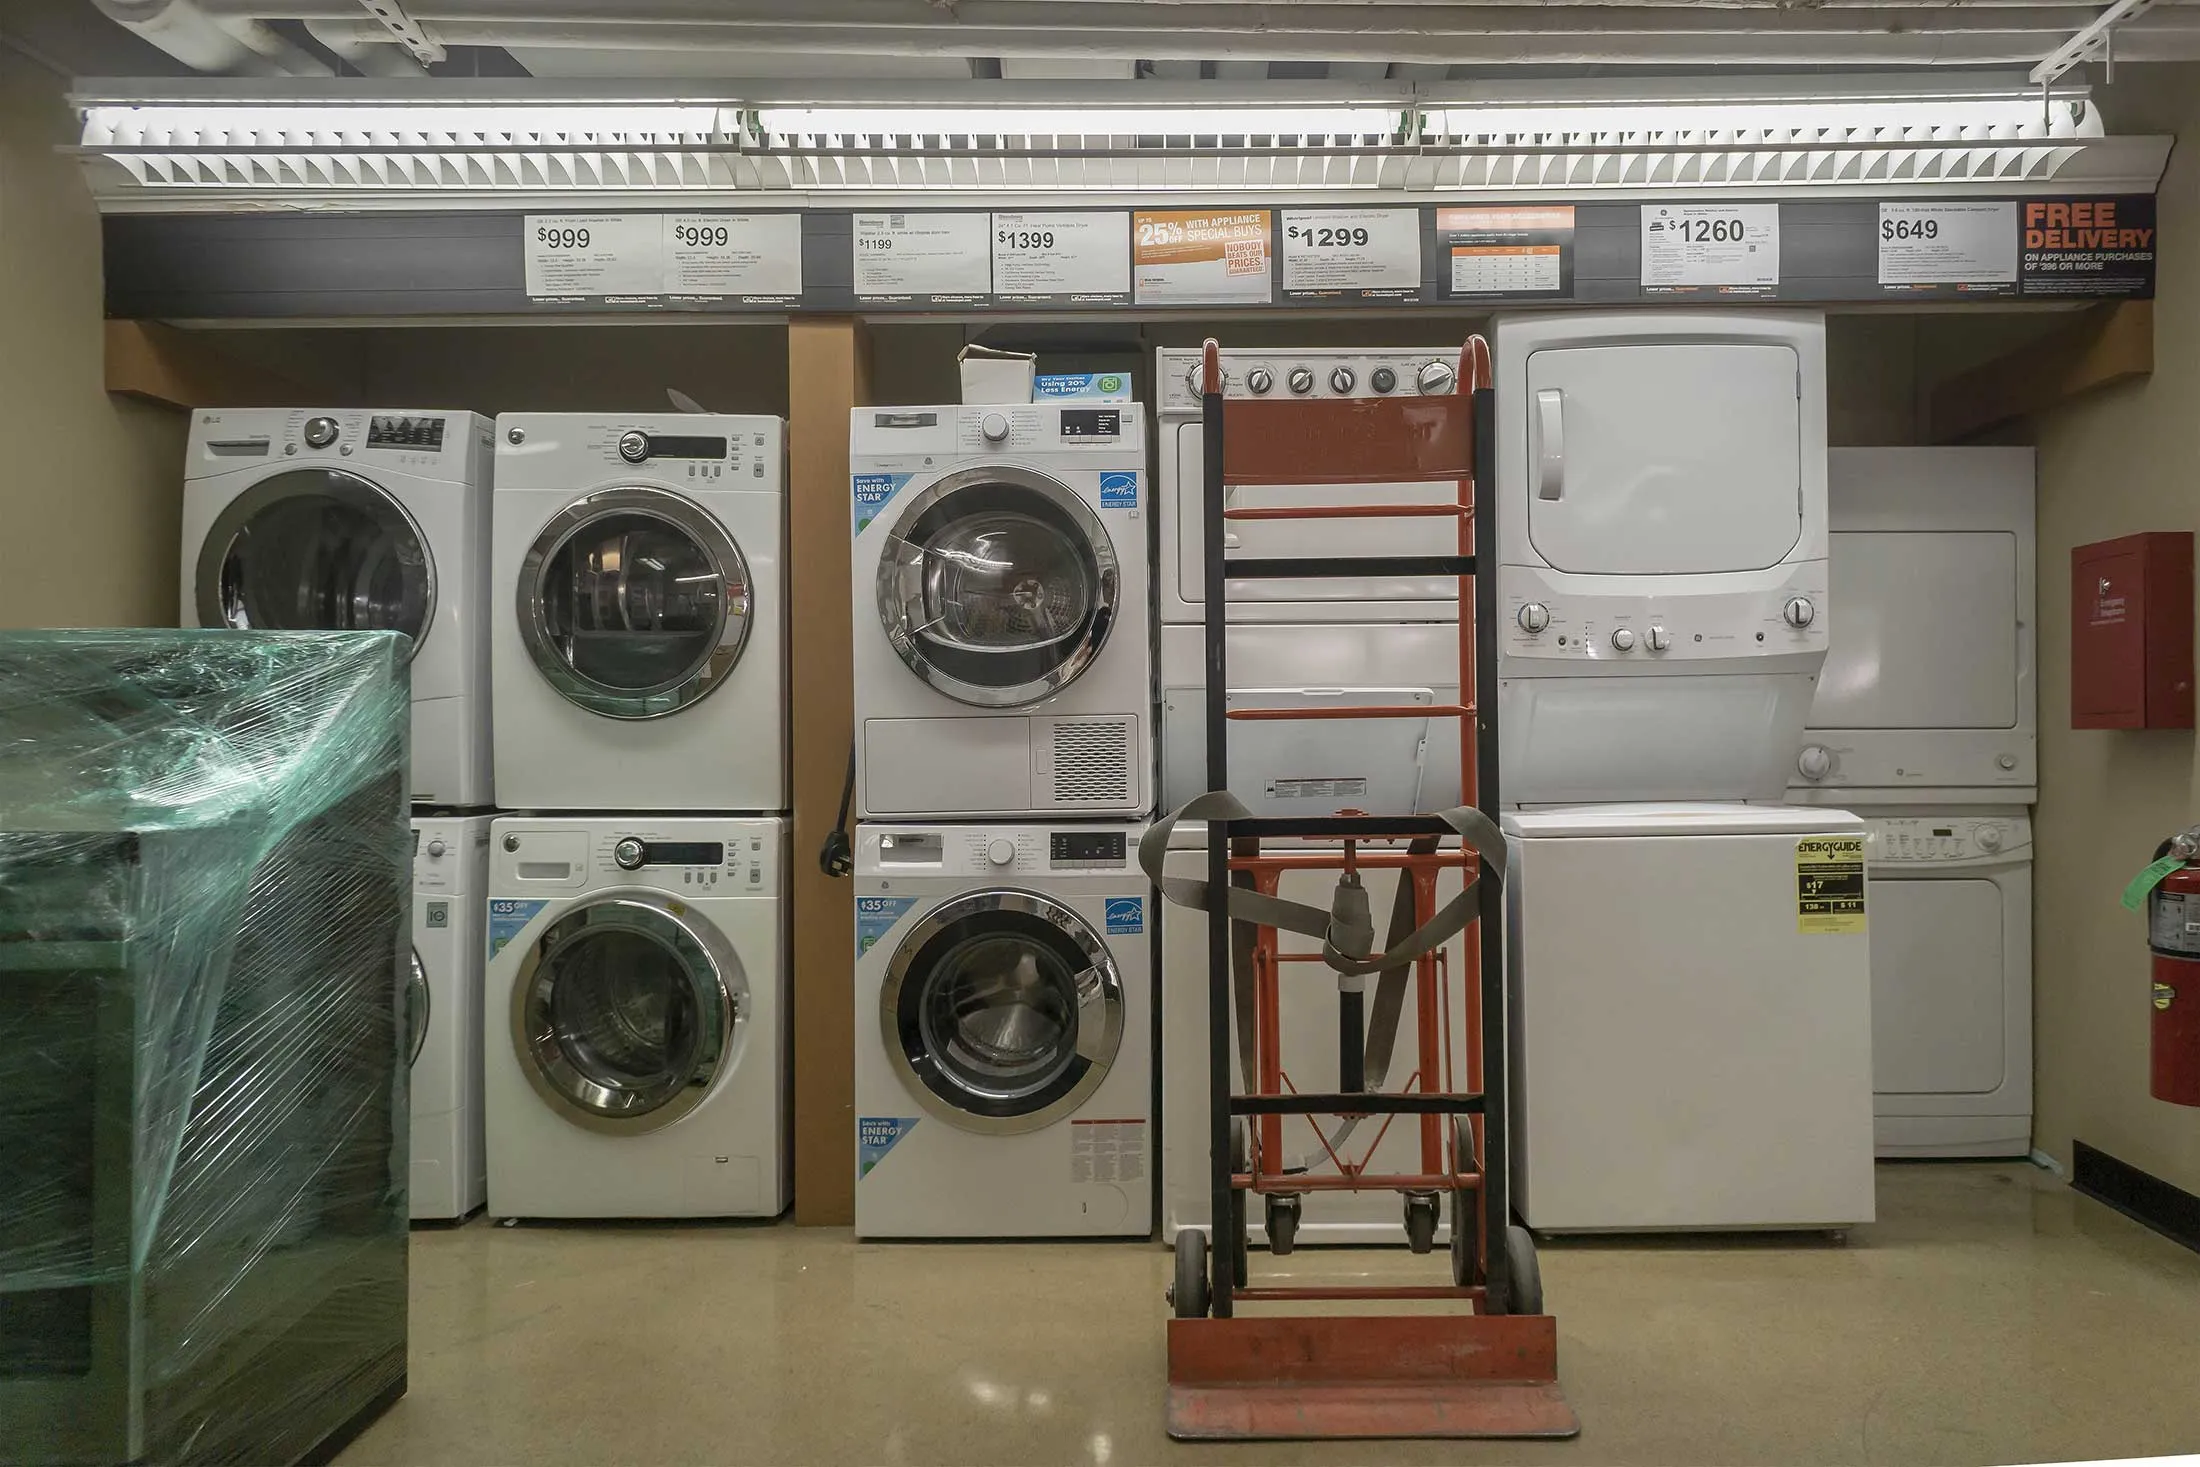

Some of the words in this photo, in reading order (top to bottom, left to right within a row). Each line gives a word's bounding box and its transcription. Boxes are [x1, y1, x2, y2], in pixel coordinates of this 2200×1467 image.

[1185, 219, 1209, 230] WITH
[1210, 213, 1261, 228] APPLIANCE
[2026, 202, 2116, 229] FREE
[675, 225, 728, 247] $999
[1139, 221, 1183, 247] 25%
[1187, 227, 1231, 242] SPECIAL
[1233, 223, 1263, 238] BUYS
[1287, 225, 1369, 247] $1299
[1669, 219, 1744, 242] $1260
[1881, 219, 1939, 242] $649
[537, 226, 591, 249] $999
[998, 230, 1054, 249] $1399
[1169, 234, 1183, 244] OFF
[2025, 229, 2153, 249] DELIVERY
[859, 238, 892, 250] $1199
[1226, 241, 1262, 253] NOBODY
[1248, 249, 1263, 257] OUR
[2024, 253, 2039, 261] ON
[2040, 253, 2094, 261] APPLIANCE
[2095, 252, 2153, 261] PURCHASES
[1228, 257, 1264, 269] PRICES.
[2024, 262, 2038, 270] OF
[2059, 262, 2073, 270] OR
[2075, 262, 2104, 270] MORE
[1041, 380, 1066, 388] Using
[1061, 386, 1091, 394] Energy
[856, 483, 895, 493] ENERGY
[856, 493, 882, 502] STAR
[493, 901, 514, 914] $35
[860, 899, 881, 912] $35
[881, 899, 897, 908] OFF
[862, 1126, 902, 1136] ENERGY
[862, 1136, 887, 1145] STAR
